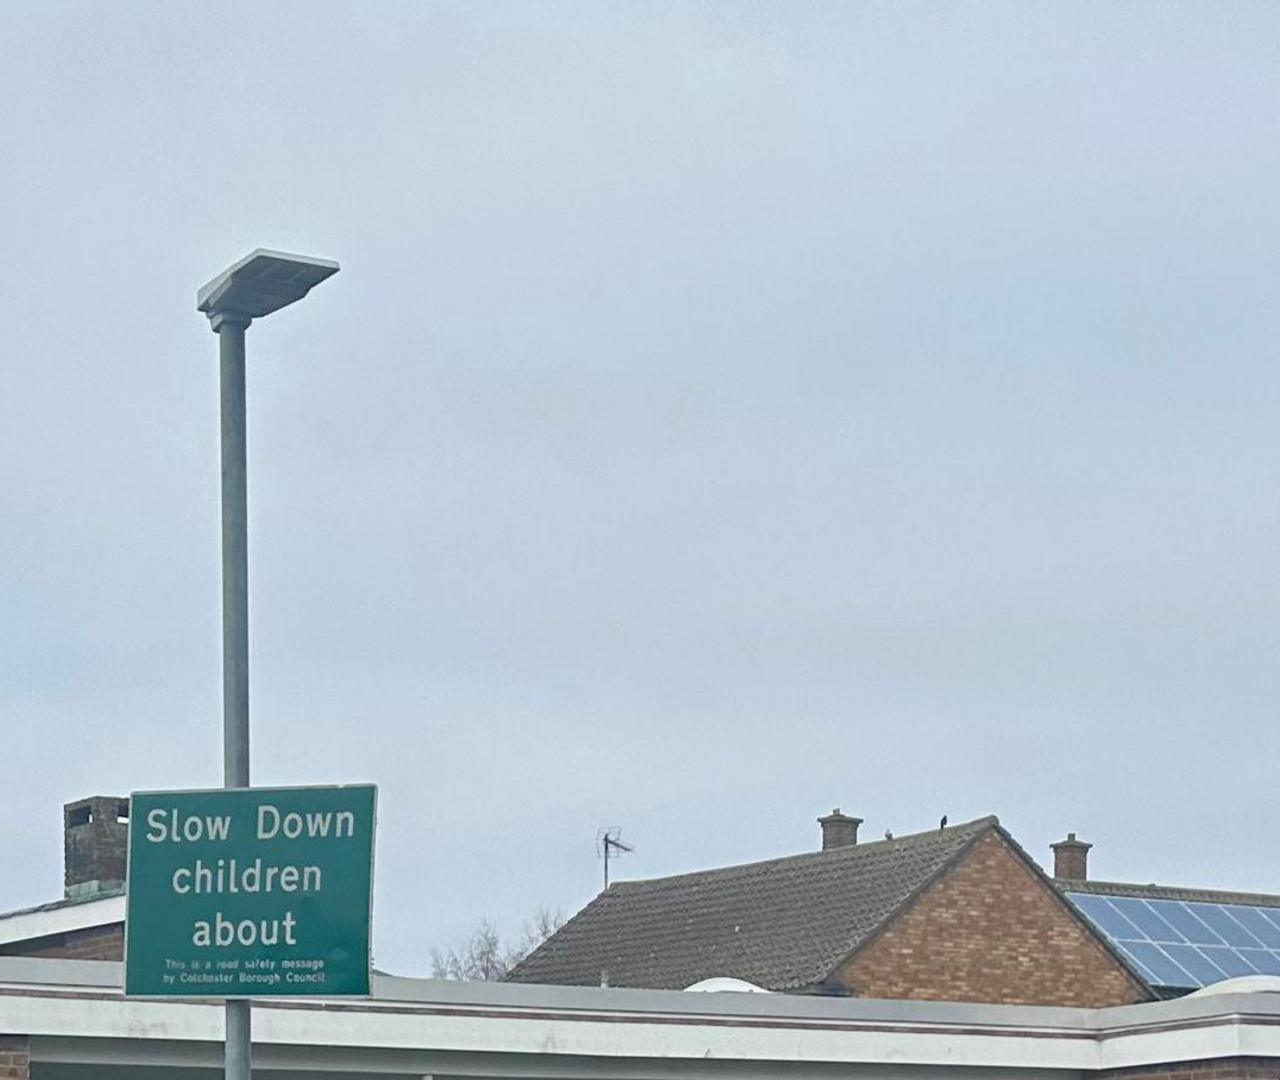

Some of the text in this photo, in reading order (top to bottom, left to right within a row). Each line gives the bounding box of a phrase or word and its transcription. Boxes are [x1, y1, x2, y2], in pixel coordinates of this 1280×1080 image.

[146, 805, 355, 843] Slow Down
[172, 858, 322, 894] children
[192, 911, 297, 946] about
[162, 971, 326, 985] by Colchester Borough Council
[165, 958, 325, 971] This is a road safety message
